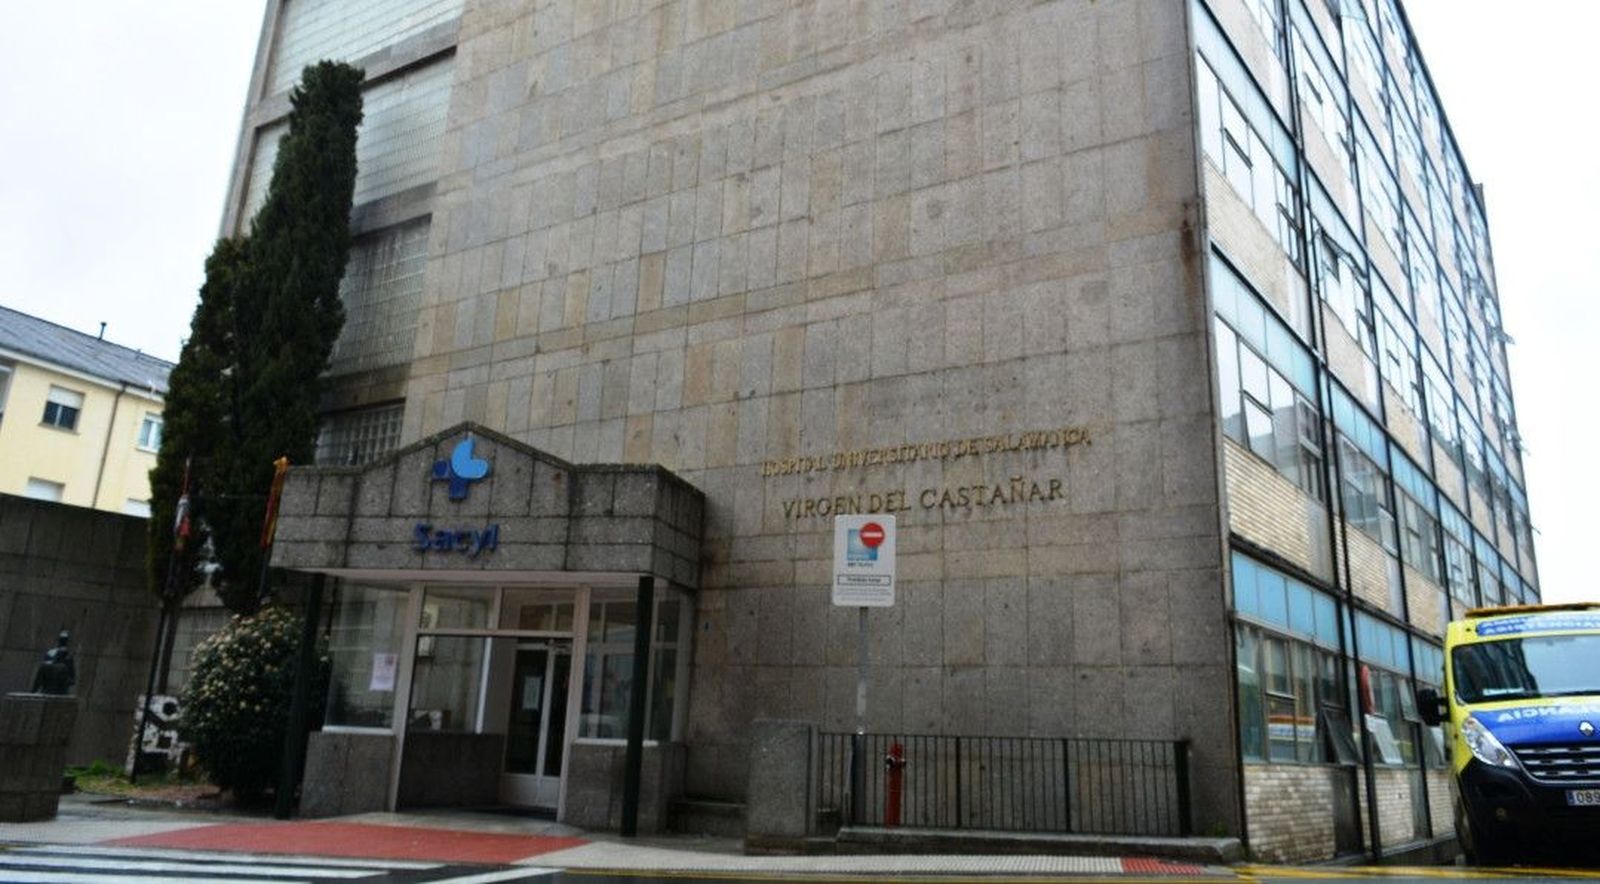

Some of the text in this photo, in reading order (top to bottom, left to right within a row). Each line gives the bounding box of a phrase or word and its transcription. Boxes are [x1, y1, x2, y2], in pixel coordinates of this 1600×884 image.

[761, 456, 827, 477] HOSPITAL
[952, 438, 980, 459] DE
[983, 428, 1092, 453] SALAMANCA
[869, 490, 911, 514] DEL
[920, 475, 1064, 510] CASTAÑAR
[413, 523, 499, 559] Sacyl
